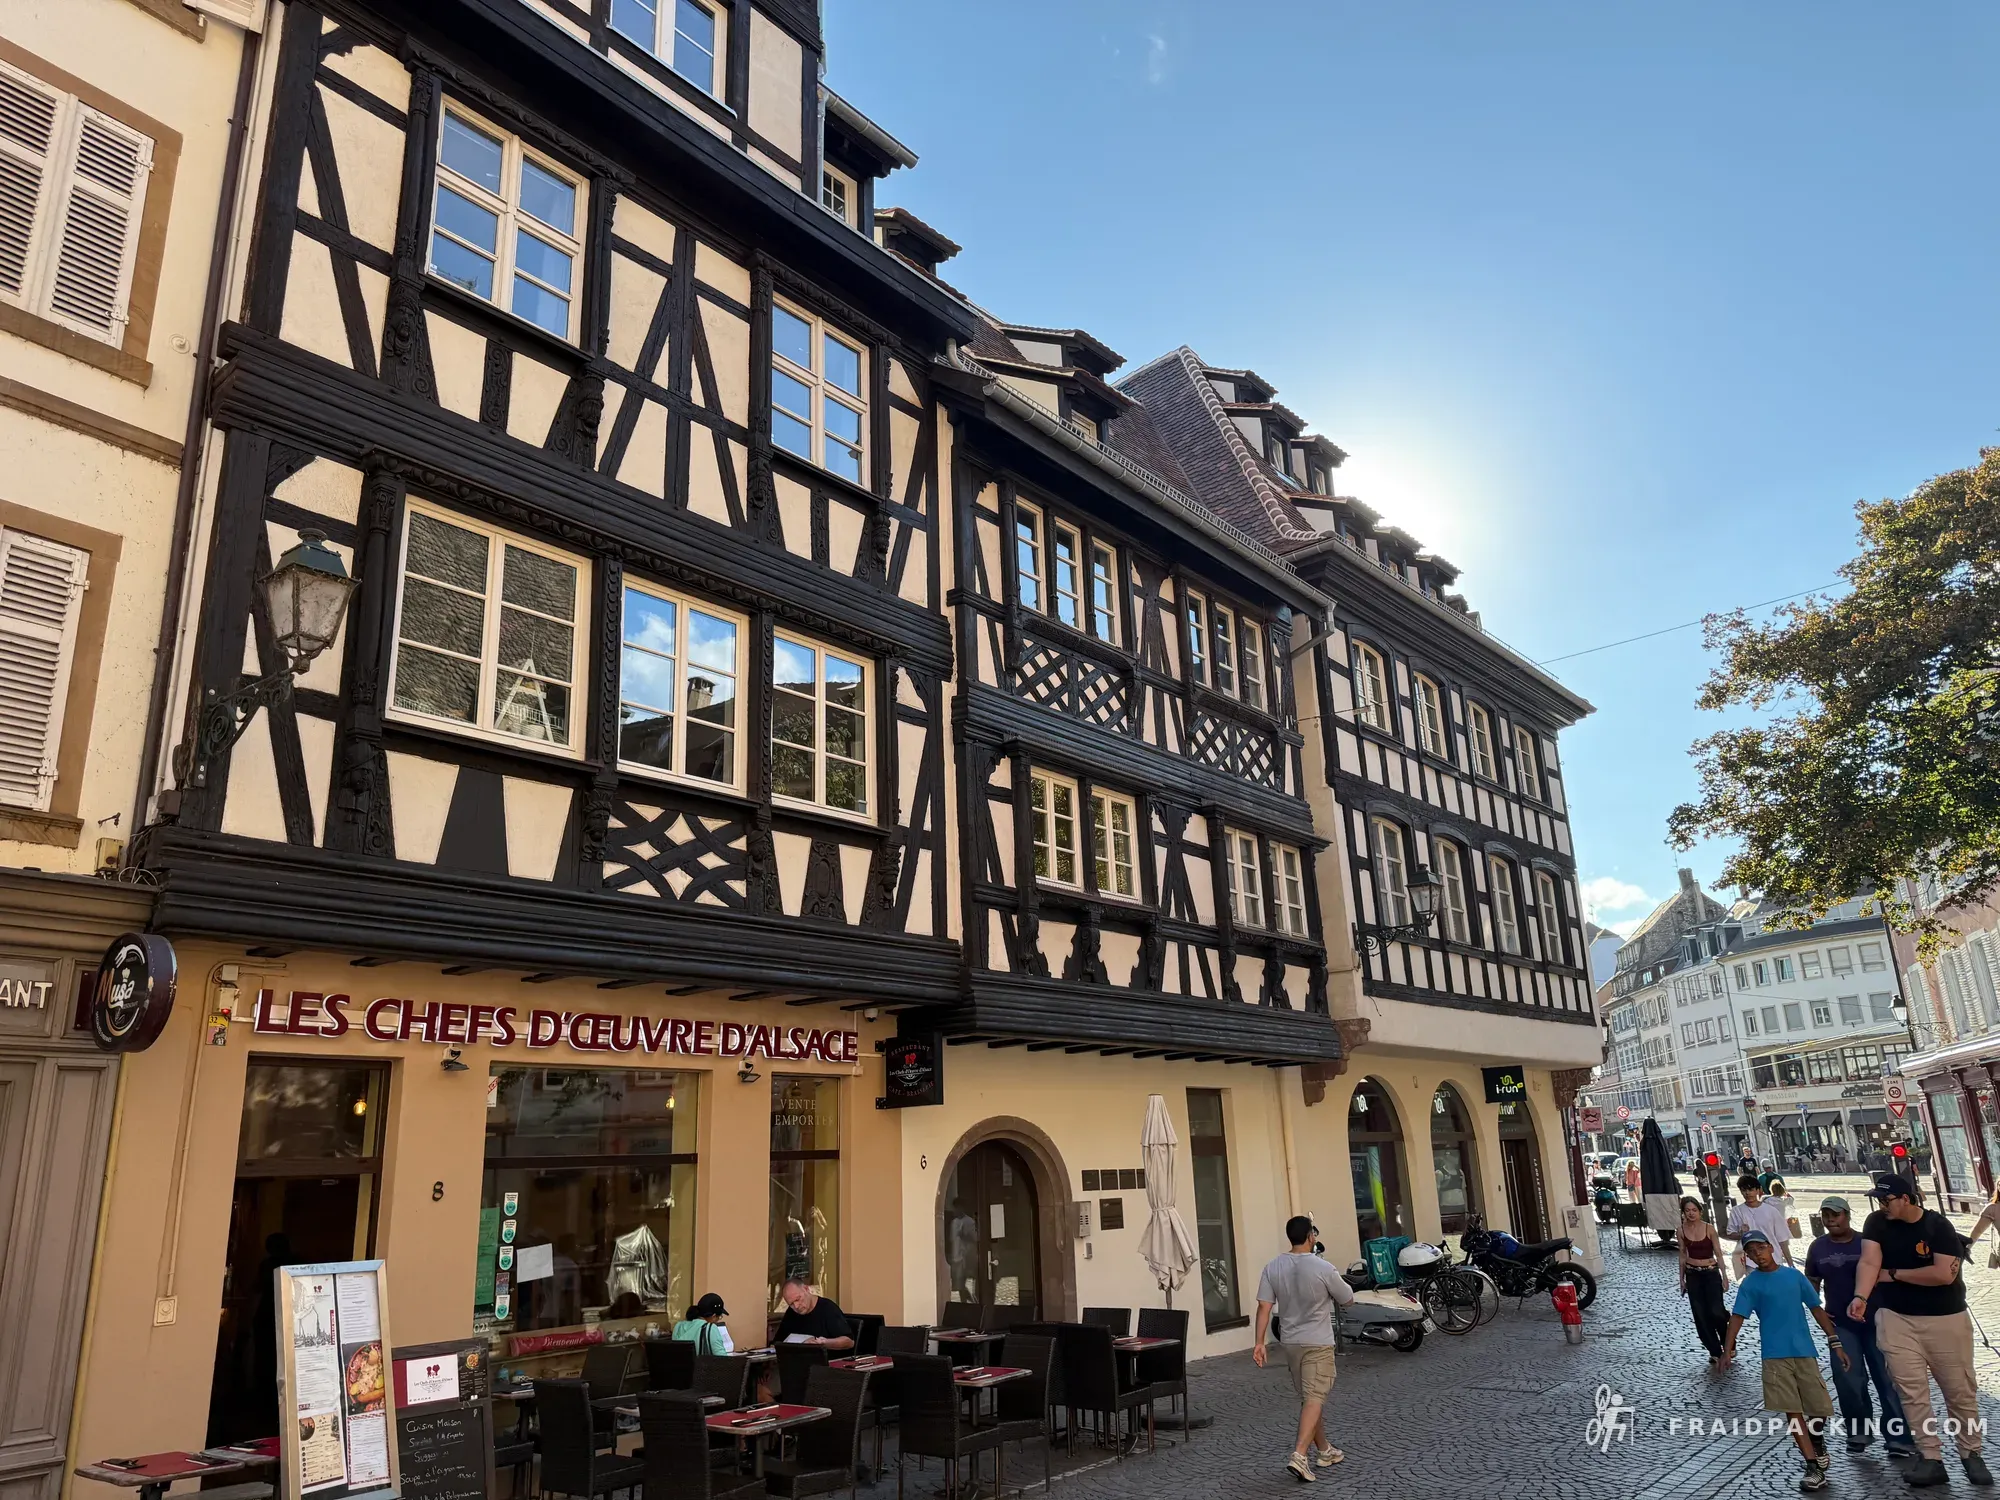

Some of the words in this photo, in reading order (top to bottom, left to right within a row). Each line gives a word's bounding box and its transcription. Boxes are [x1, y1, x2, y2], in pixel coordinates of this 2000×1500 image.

[0, 978, 53, 1009] ANT
[95, 967, 135, 1009] Musa
[209, 1015, 218, 1024] 32
[254, 988, 350, 1038] LES
[364, 997, 517, 1047] CHEFS
[719, 1022, 859, 1062] D'ALSACE
[1496, 1083, 1519, 1094] i-run
[780, 1098, 817, 1110] VENTE
[775, 1114, 834, 1126] EMPORTER
[920, 1155, 928, 1169] 6
[432, 1181, 444, 1202] 8
[406, 1420, 434, 1433] Cuisine
[437, 1418, 462, 1427] Maison
[400, 1472, 421, 1485] Soupe
